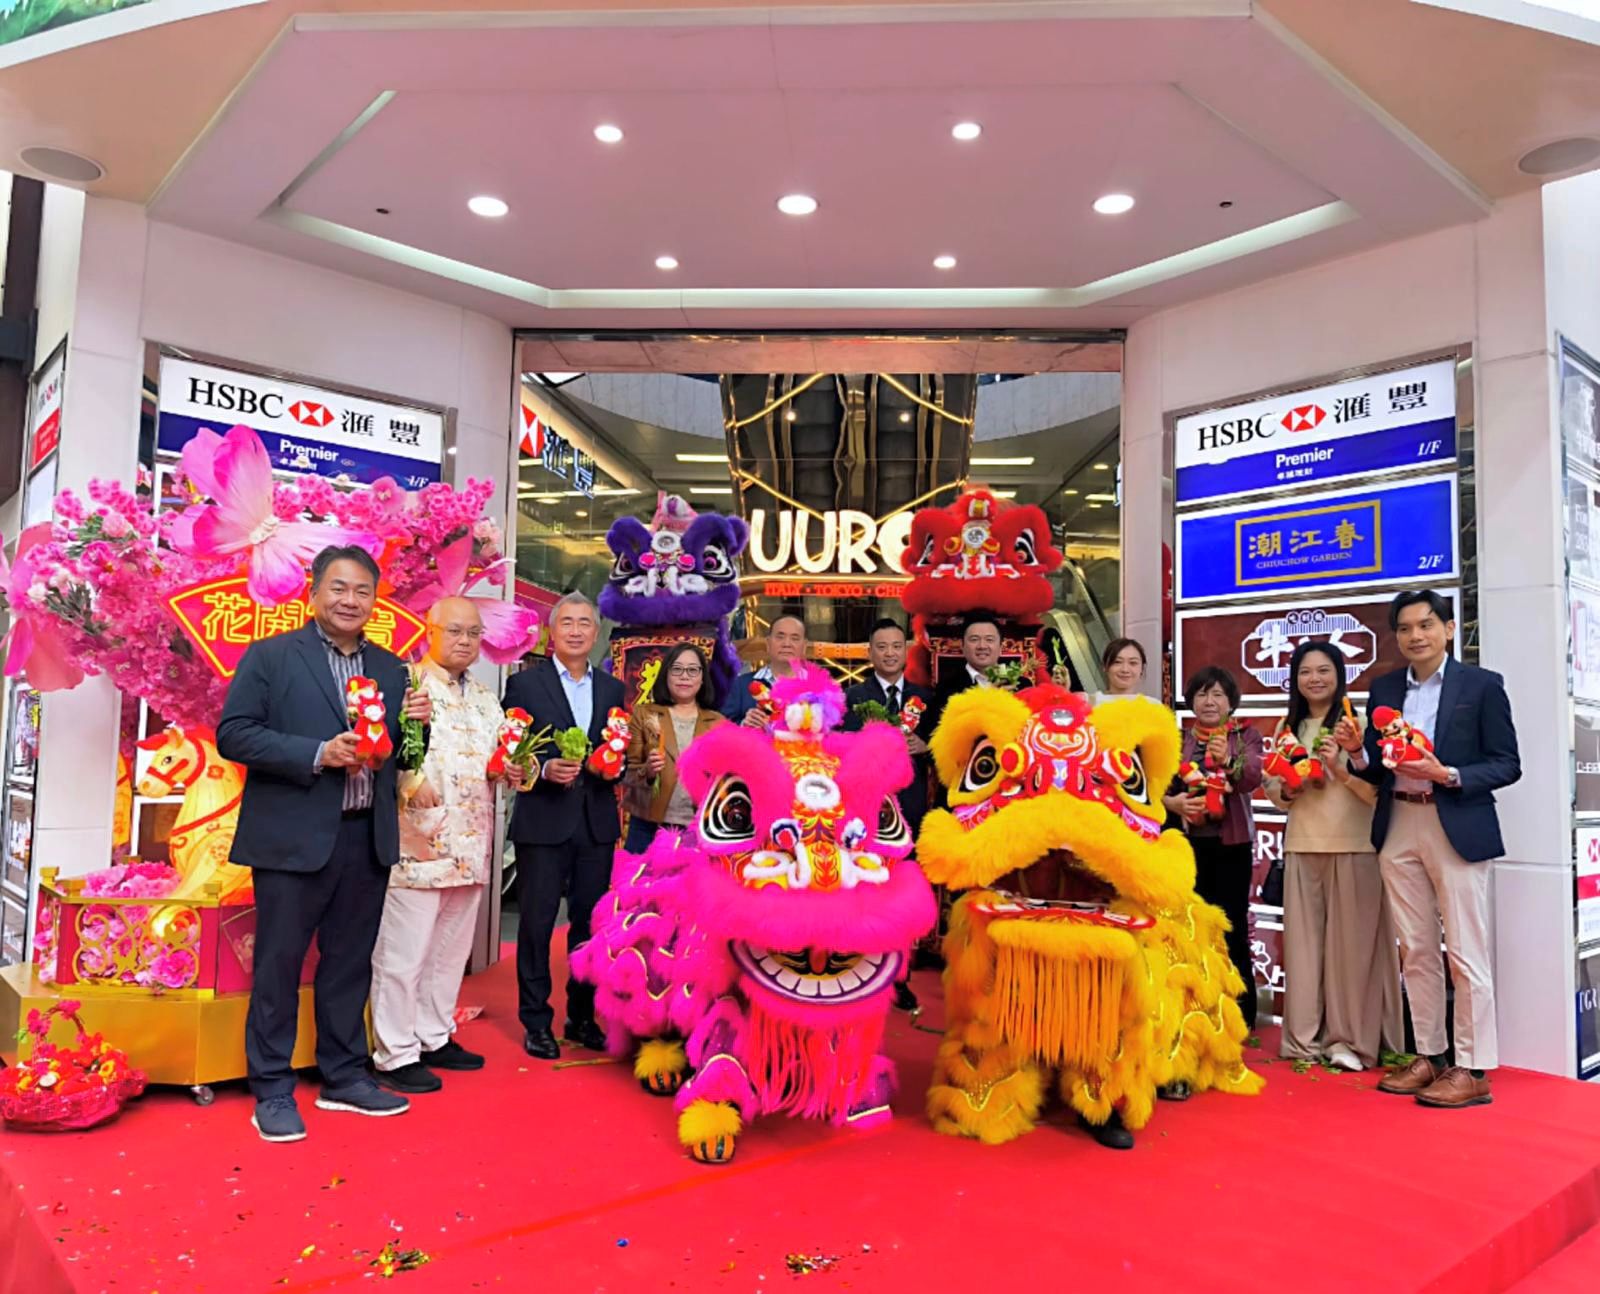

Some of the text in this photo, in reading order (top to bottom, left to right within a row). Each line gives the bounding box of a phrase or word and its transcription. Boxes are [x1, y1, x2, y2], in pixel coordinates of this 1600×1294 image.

[188, 377, 283, 419] HSBC
[1197, 413, 1277, 451] HSBC
[280, 439, 339, 462] Premier
[1275, 447, 1334, 469] Premier
[1248, 518, 1365, 559] 潮江春
[1311, 550, 1353, 564] GARDEN
[1417, 554, 1445, 570] 2/F
[764, 582, 803, 597] ITALY
[814, 583, 864, 597] TOKYO
